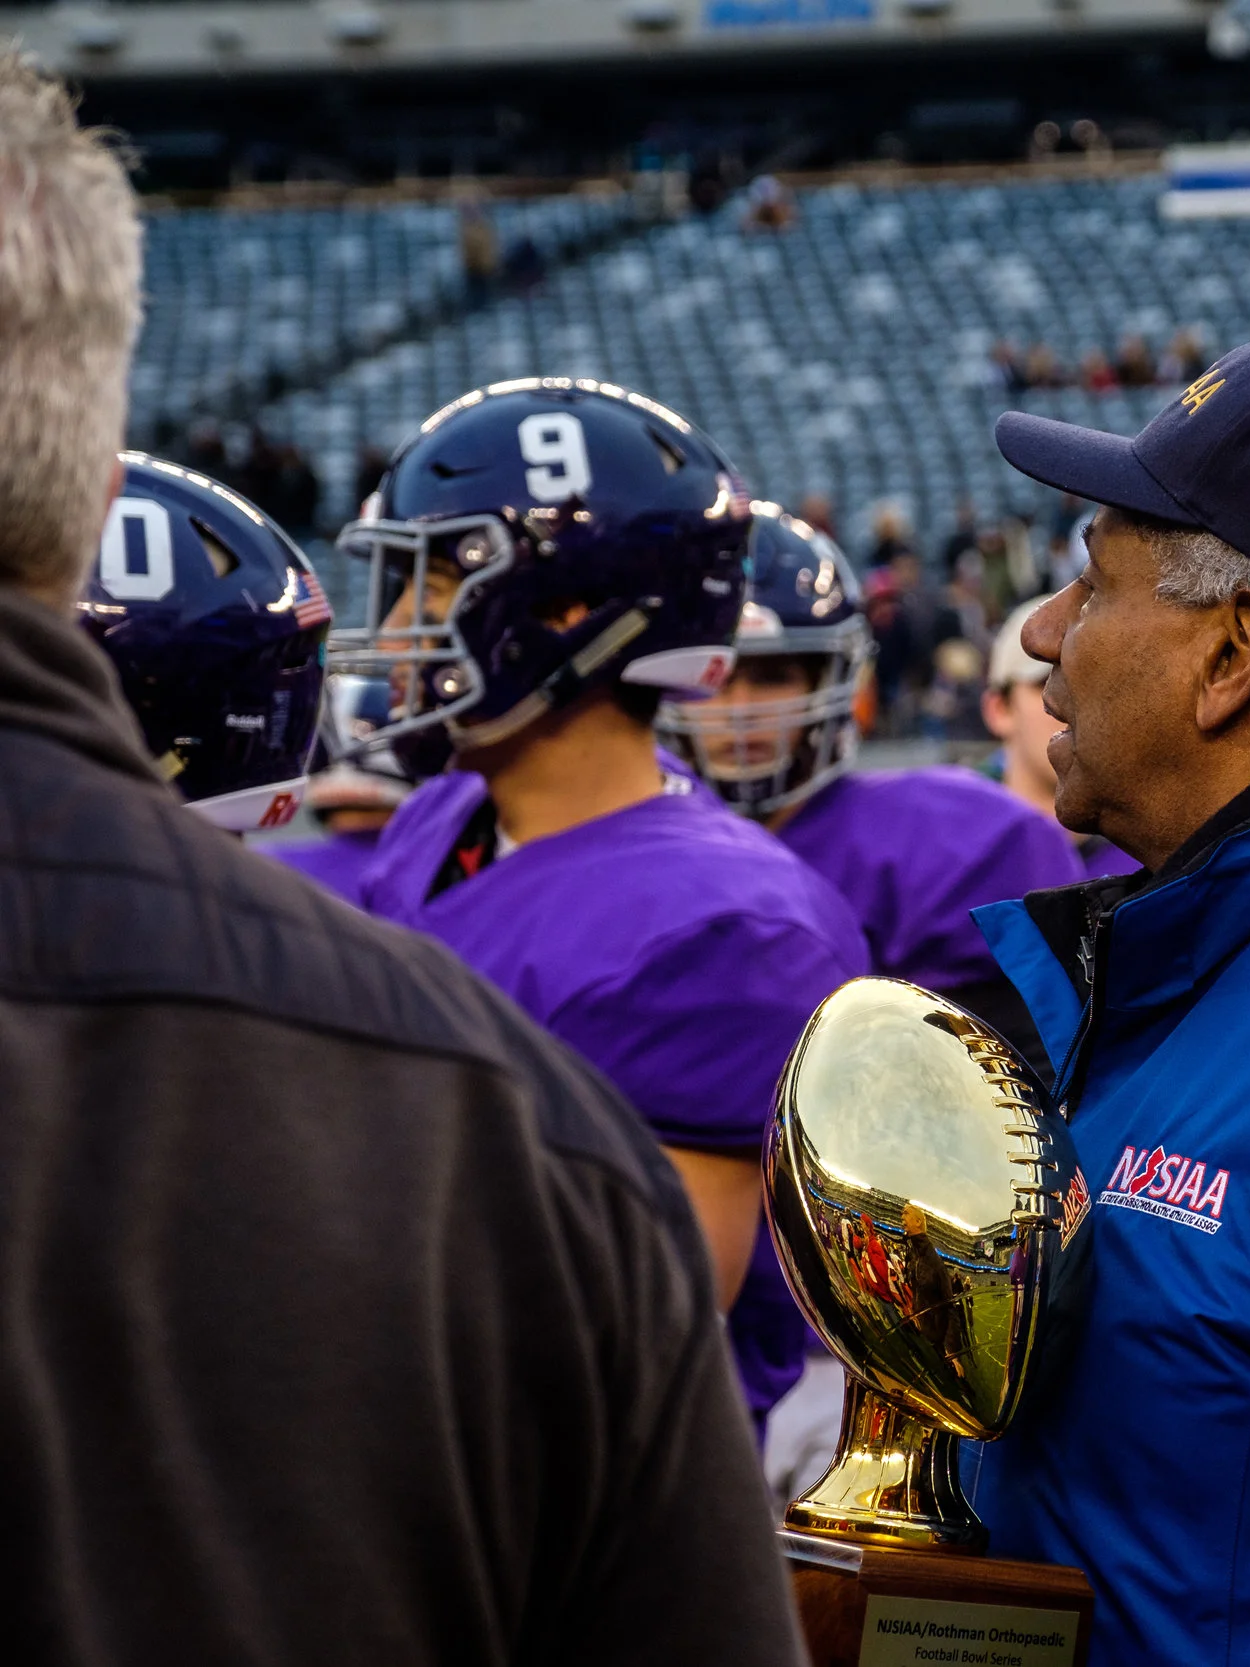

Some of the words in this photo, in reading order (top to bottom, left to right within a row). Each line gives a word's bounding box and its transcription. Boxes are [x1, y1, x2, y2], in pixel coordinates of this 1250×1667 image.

[518, 411, 591, 503] 9
[877, 1618, 985, 1641] NJSIAA/Rothman
[988, 1628, 1066, 1648] Orthopaedic
[914, 1646, 959, 1662] Football
[961, 1650, 988, 1663] Bowl
[990, 1653, 1023, 1667] Series
